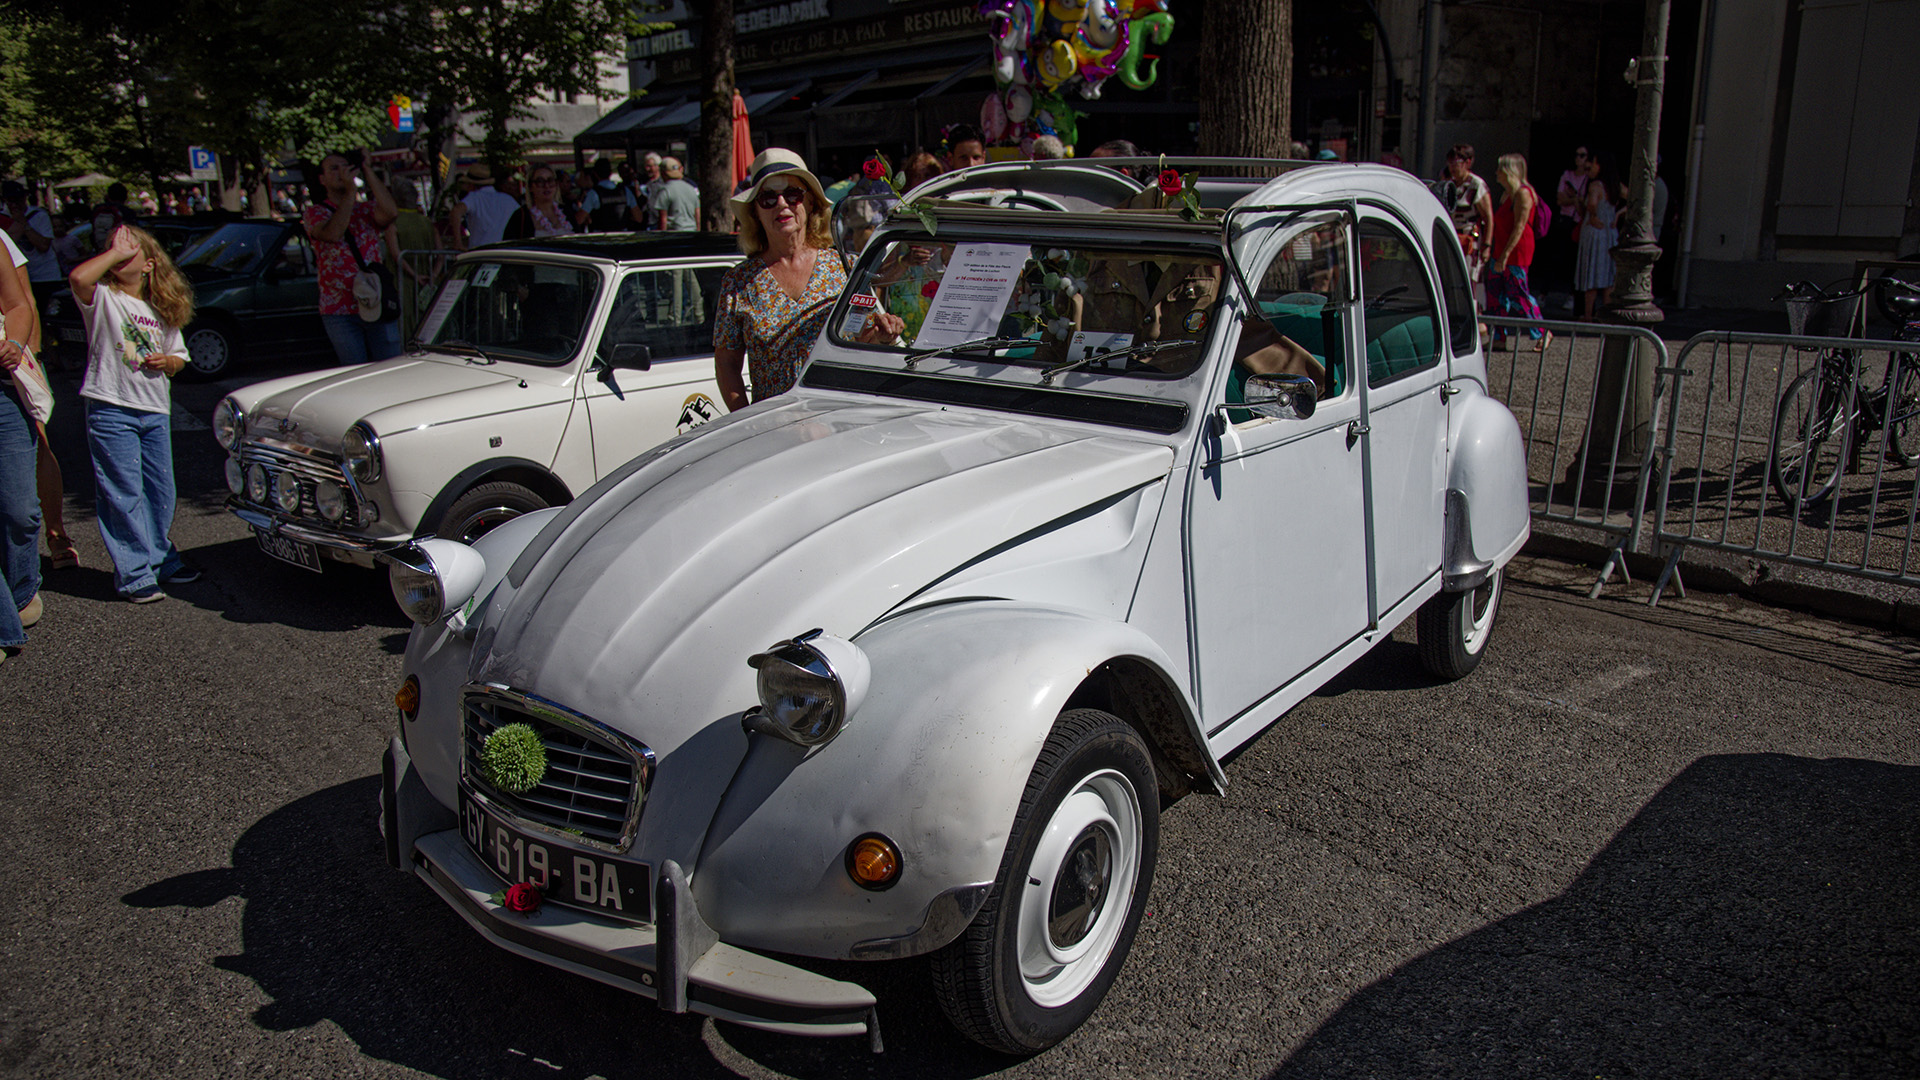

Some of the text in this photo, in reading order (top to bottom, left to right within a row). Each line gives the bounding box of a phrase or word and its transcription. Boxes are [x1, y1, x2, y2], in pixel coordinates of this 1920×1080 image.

[651, 28, 695, 56] HOTEL
[808, 31, 827, 51] DE
[833, 27, 850, 45] LA
[856, 20, 887, 42] PAIX
[197, 151, 209, 167] P
[477, 271, 491, 284] 14
[853, 296, 876, 306] D-DAY
